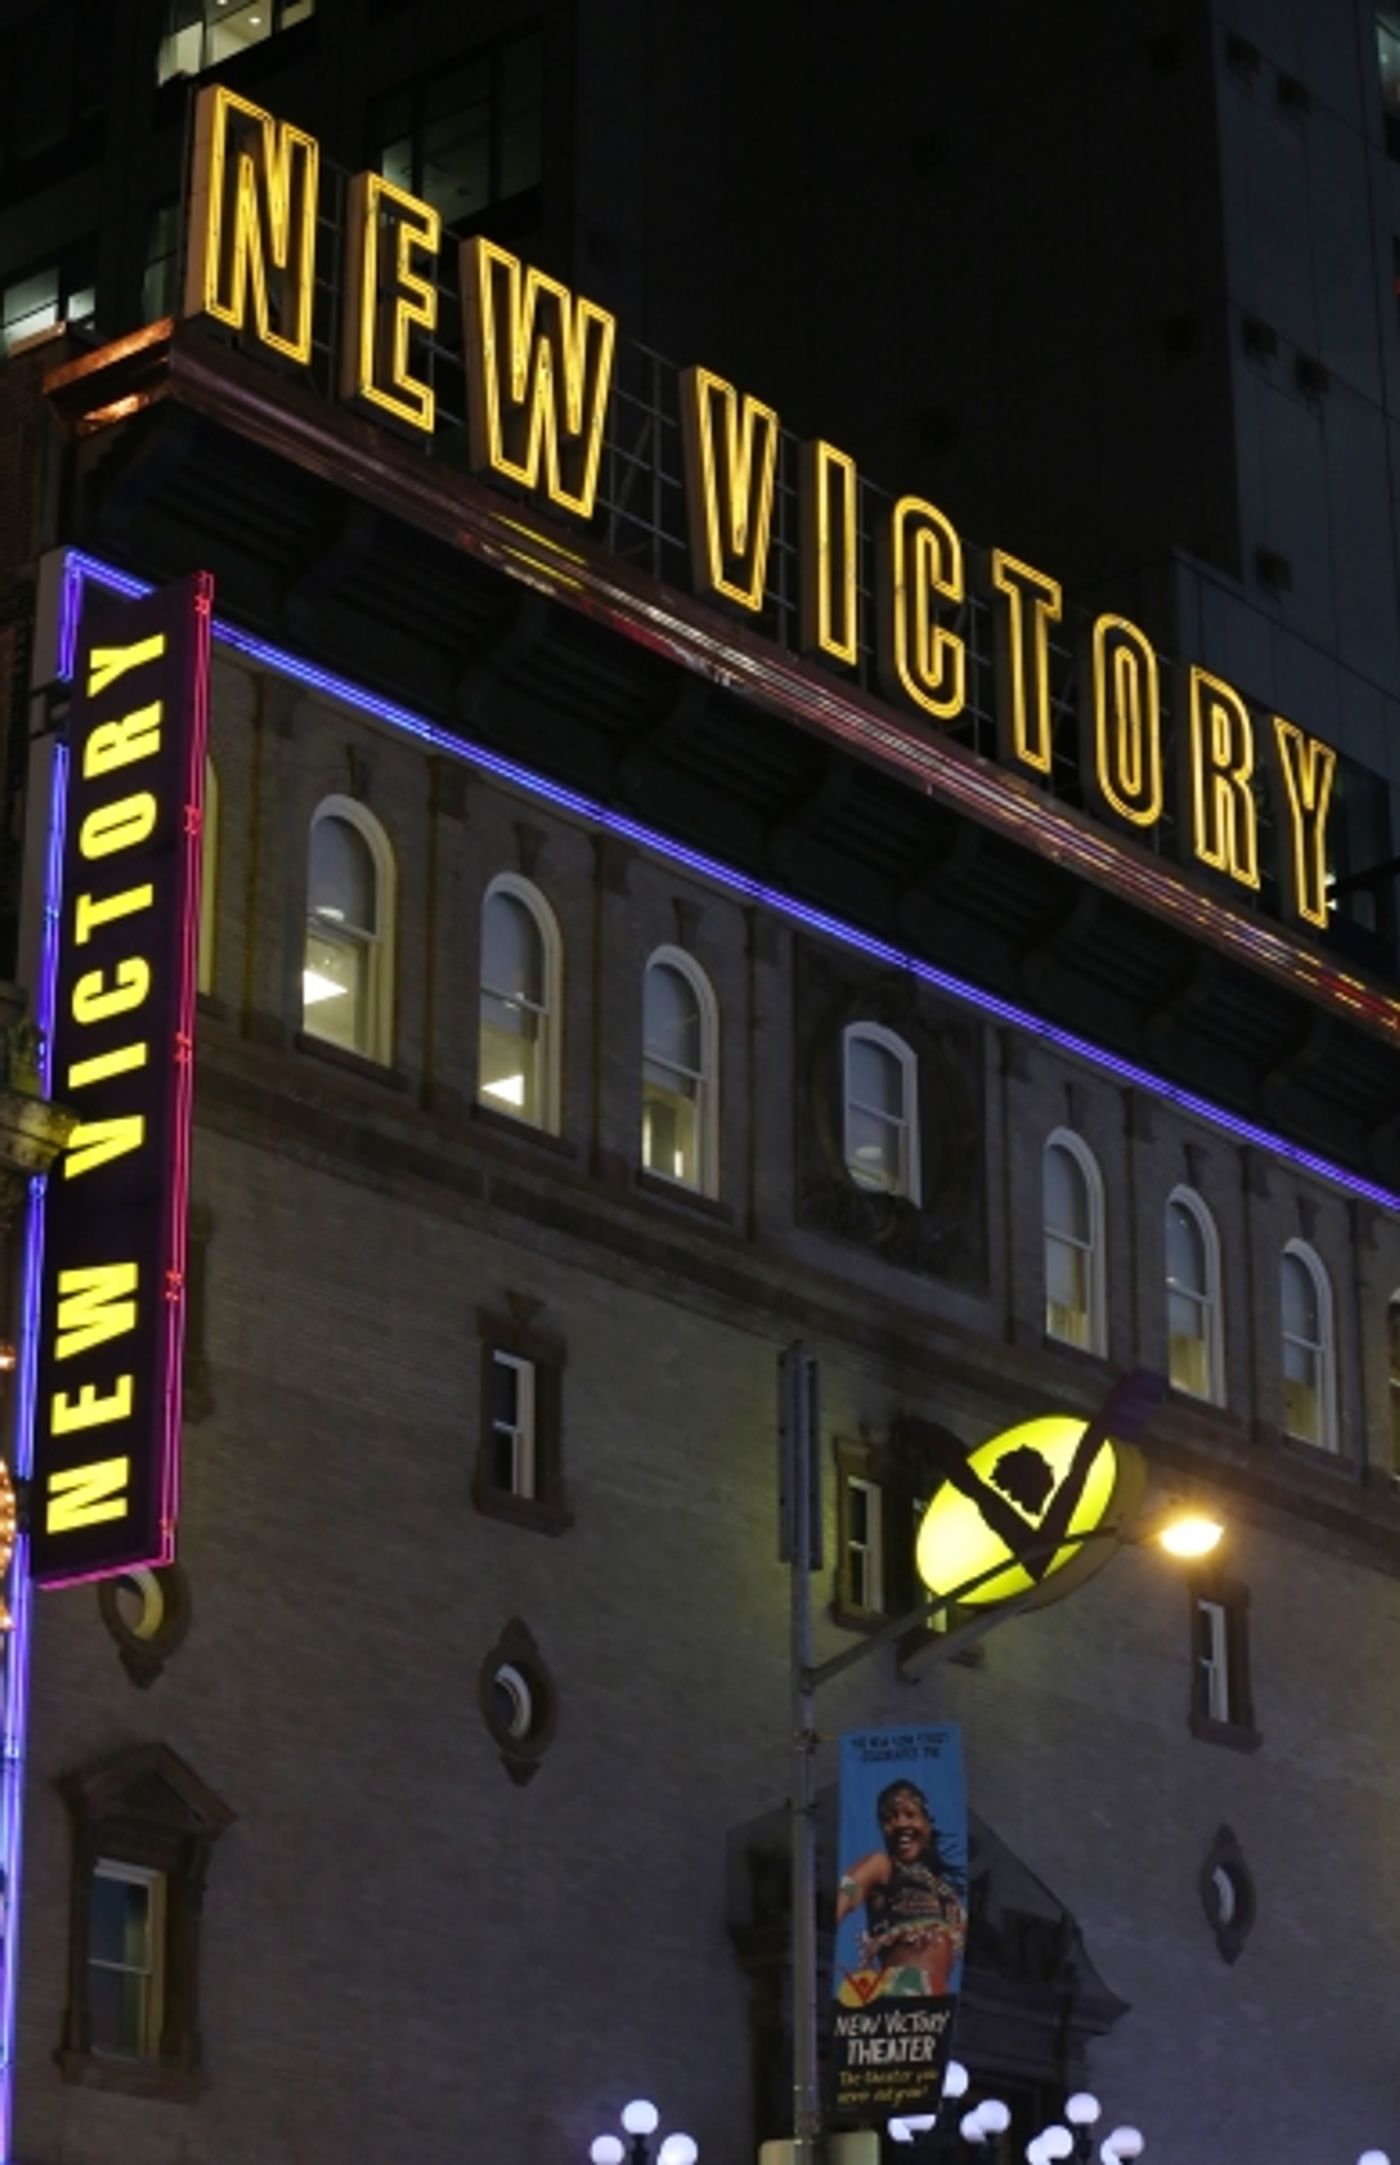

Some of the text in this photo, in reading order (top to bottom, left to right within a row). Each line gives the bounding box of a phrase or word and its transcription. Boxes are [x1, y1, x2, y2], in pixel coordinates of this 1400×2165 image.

[187, 85, 1337, 930] NEW VICTORY
[45, 633, 167, 1535] NEW VICTORY
[834, 2009, 951, 2037] NEW VICTORY
[847, 2035, 936, 2066] THEATER
[840, 2071, 862, 2087] The
[865, 2069, 913, 2084] theater
